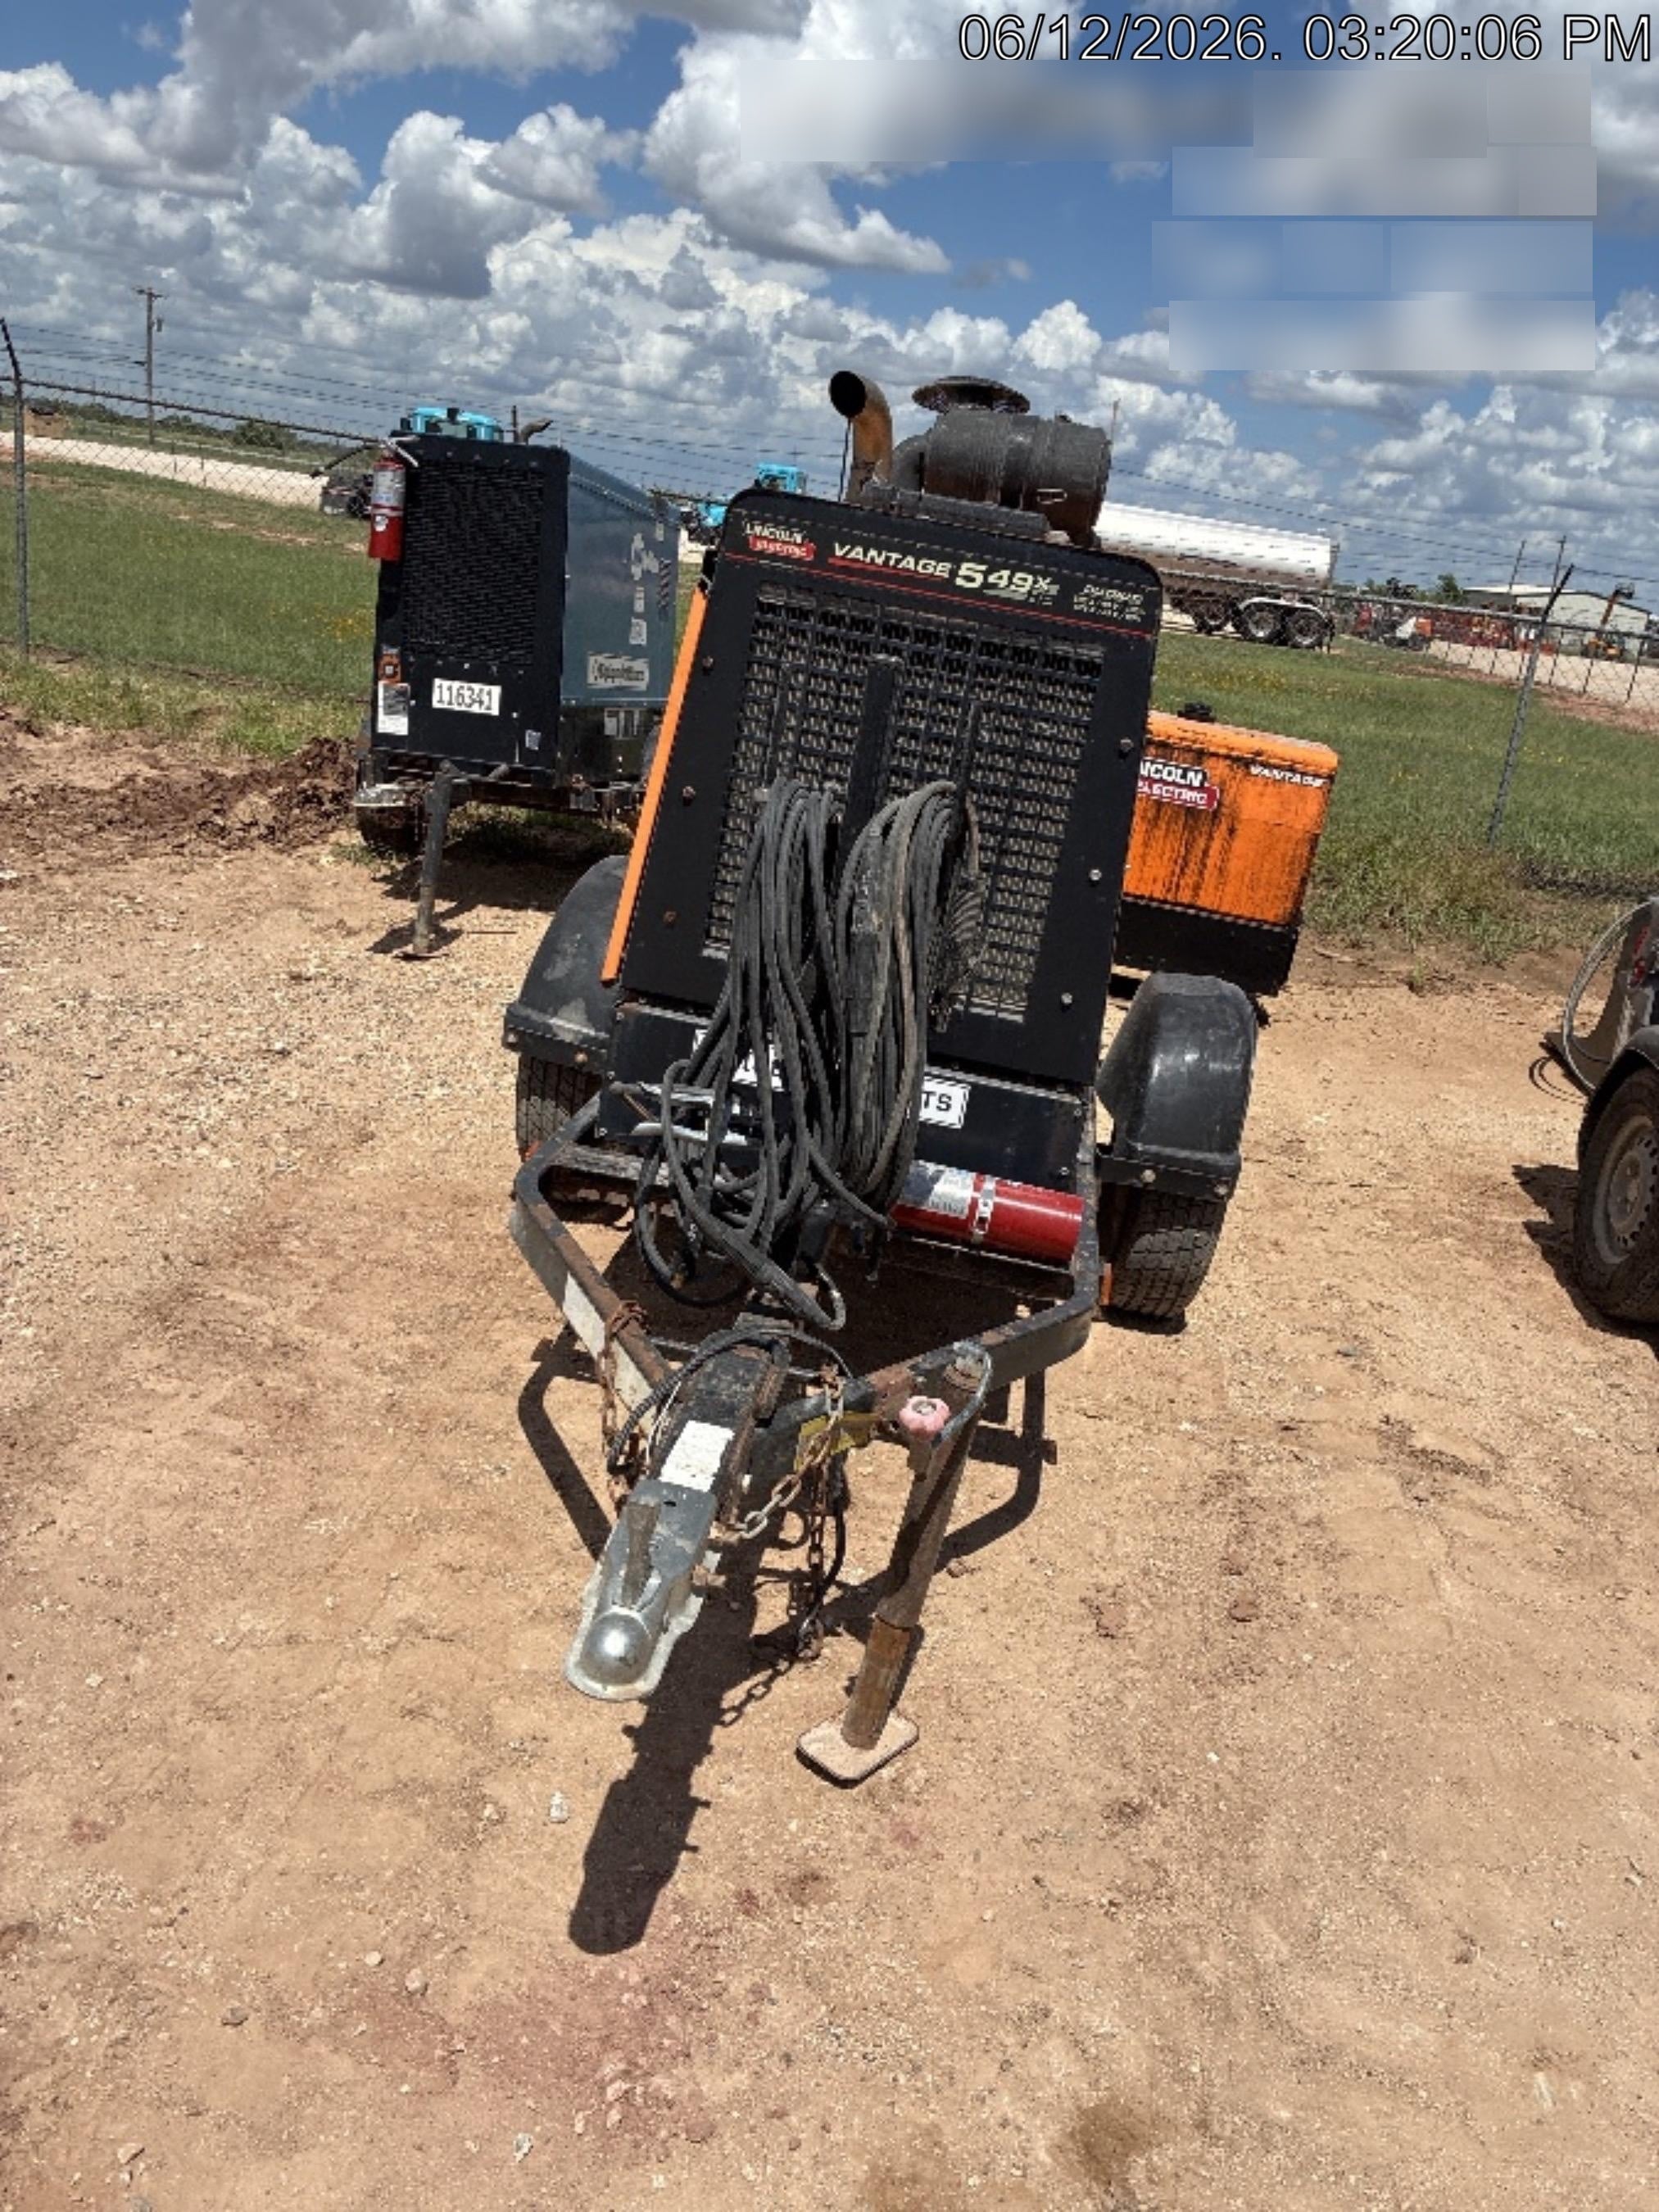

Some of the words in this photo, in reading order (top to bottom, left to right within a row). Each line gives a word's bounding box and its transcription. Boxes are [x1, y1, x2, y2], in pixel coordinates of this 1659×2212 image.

[834, 542, 953, 578] VANTAGE
[436, 682, 493, 711] 116341
[1140, 759, 1203, 787] NCOLN
[1250, 763, 1326, 787] VANTAGE
[922, 1090, 953, 1113] TS
